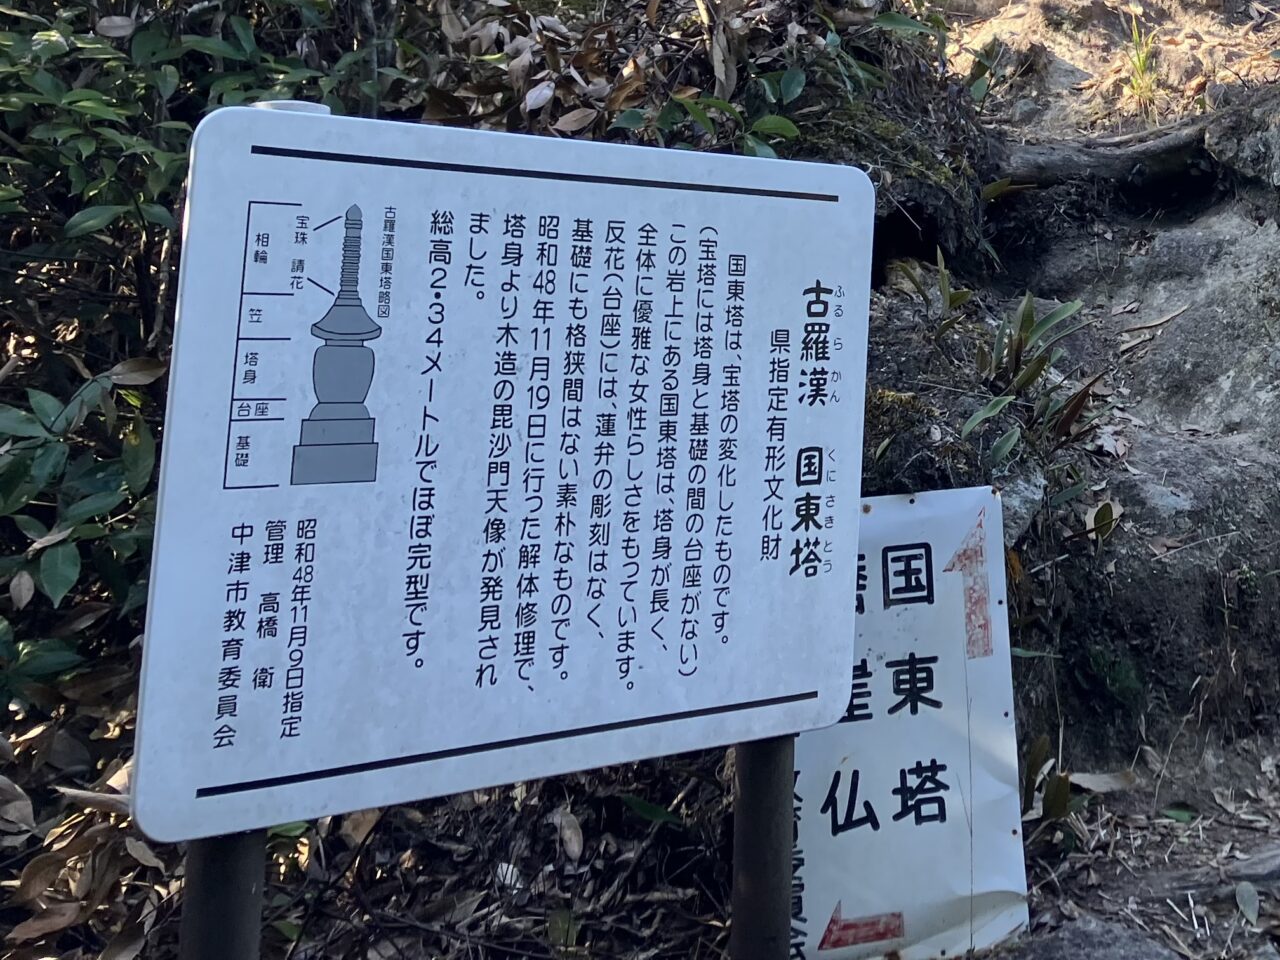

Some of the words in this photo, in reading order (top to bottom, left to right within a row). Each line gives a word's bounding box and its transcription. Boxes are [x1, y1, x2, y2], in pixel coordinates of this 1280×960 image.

[253, 232, 270, 264] 相輪
[290, 259, 305, 290] 請花
[294, 215, 310, 245] 宝珠
[377, 206, 397, 318] 古羅漢国東塔略図
[464, 212, 491, 300] ました。
[242, 352, 259, 384] 塔身
[248, 308, 263, 324] 笠
[798, 279, 833, 407] 古羅漢
[234, 435, 251, 468] 基礎
[236, 402, 270, 417] 台座
[475, 213, 526, 689] 塔身より木造の毘沙門天像が発見され
[548, 217, 594, 681] 基礎にも格狭間はない素朴なものです。
[615, 222, 659, 691] 全体に優雅な女性らしさをもっています。
[711, 254, 747, 644] 国東塔は、宝塔の変化したものです。
[759, 328, 791, 562] 県指定有形文化財
[262, 520, 287, 565] 管理
[788, 446, 824, 579] 国東塔
[212, 522, 254, 750] 中津市教育委員会
[256, 591, 281, 640] 高橋
[280, 518, 318, 740] 昭和48年11月9日指定
[881, 541, 951, 827] 国東塔
